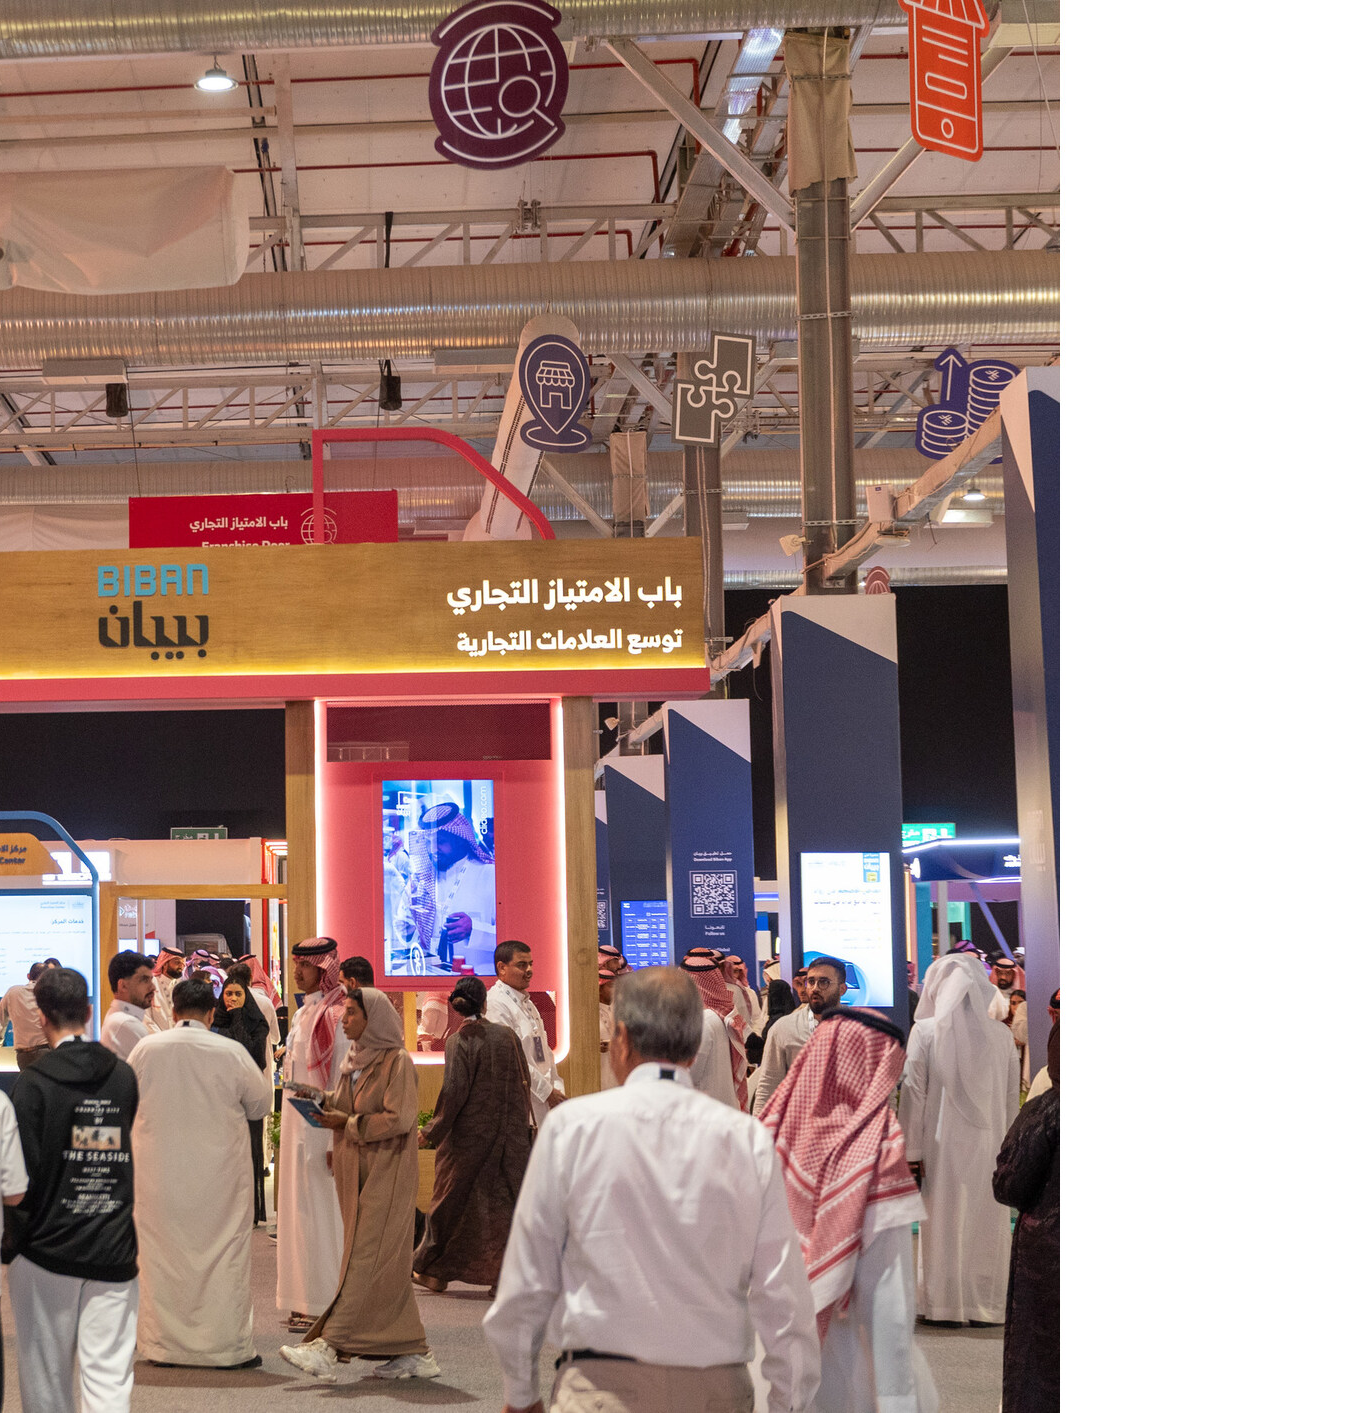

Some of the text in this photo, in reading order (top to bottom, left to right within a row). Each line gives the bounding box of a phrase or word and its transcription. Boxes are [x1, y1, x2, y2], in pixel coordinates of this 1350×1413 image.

[189, 516, 289, 533] باب الامتياز التجاري
[97, 563, 209, 597] BIBAN
[446, 576, 683, 615] باب الامتياز التجاري
[98, 600, 209, 661] بيبان
[456, 628, 684, 657] توسع العلامات التجارية
[0, 856, 26, 865] Center
[62, 1150, 130, 1163] THE SEASIDE
